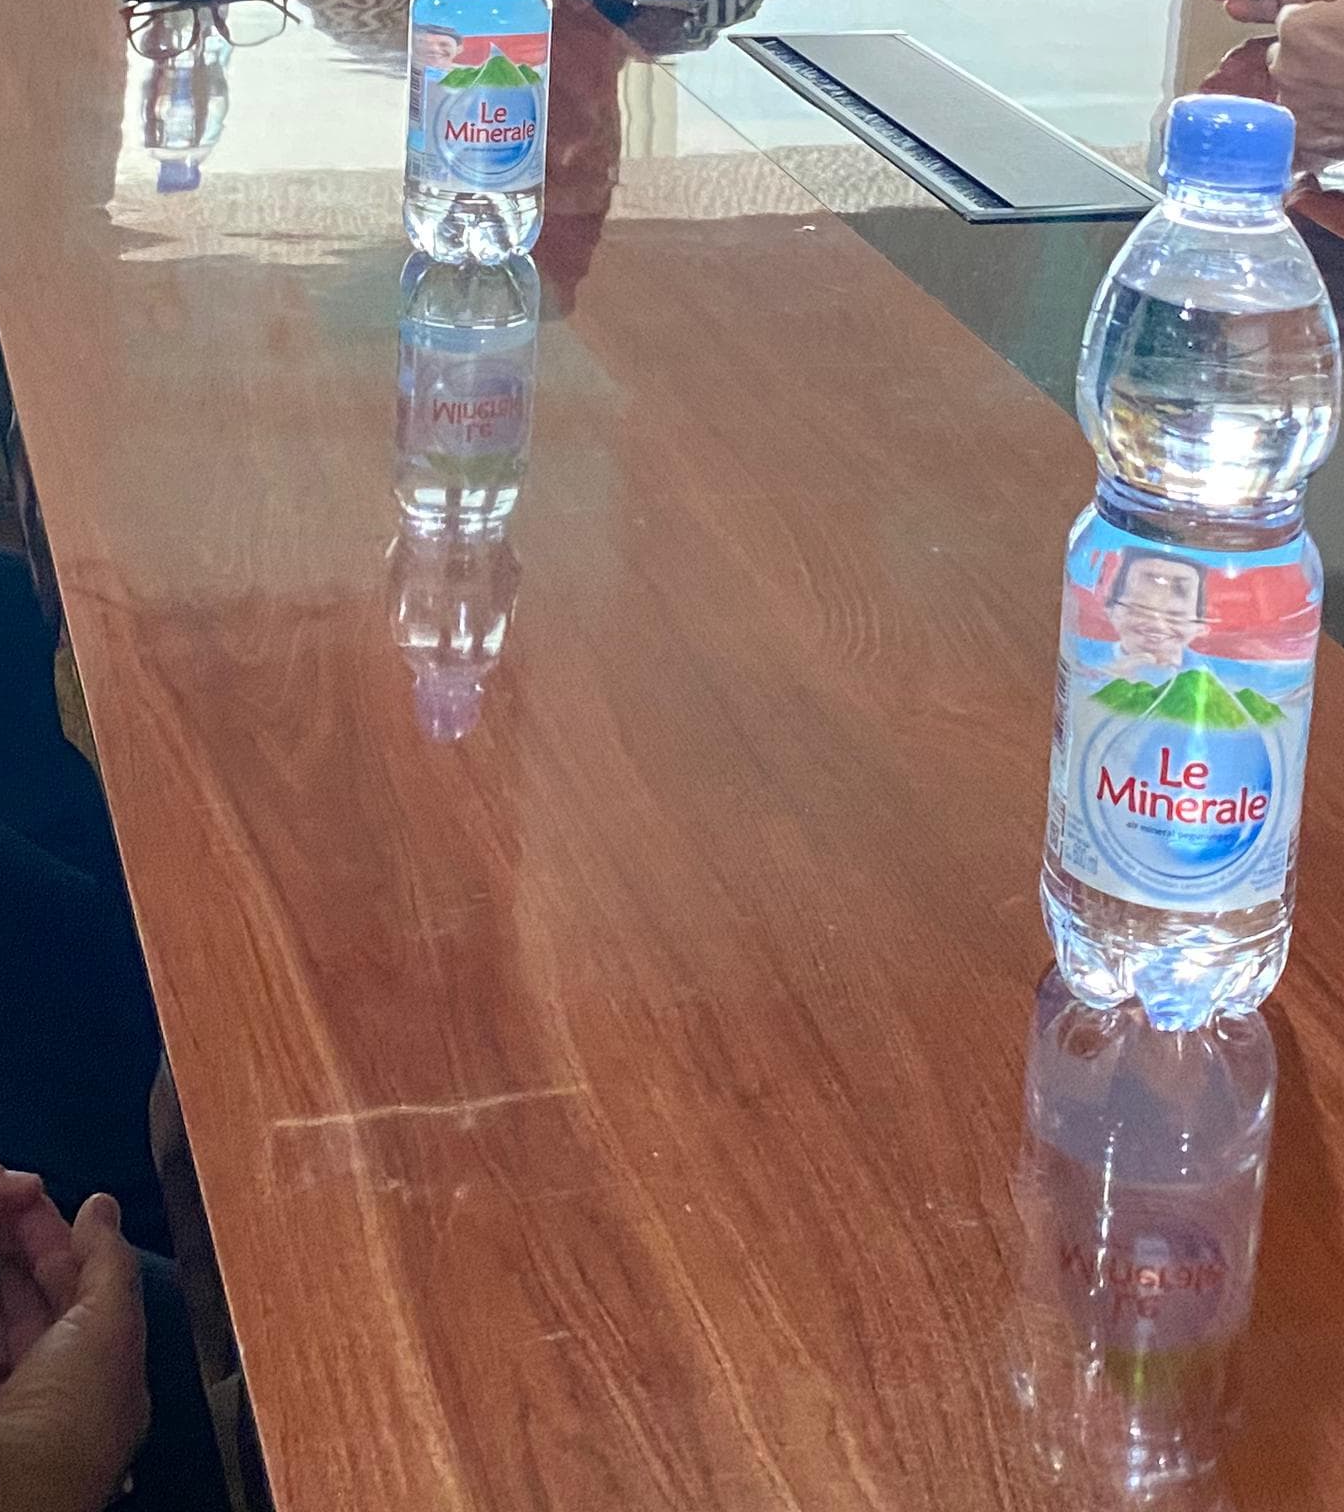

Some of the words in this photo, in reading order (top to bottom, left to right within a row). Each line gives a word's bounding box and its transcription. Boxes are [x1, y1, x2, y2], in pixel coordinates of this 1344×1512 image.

[481, 101, 507, 124] Le
[445, 119, 536, 143] Minerale
[1159, 746, 1210, 790] Le
[1095, 765, 1268, 825] Minerale
